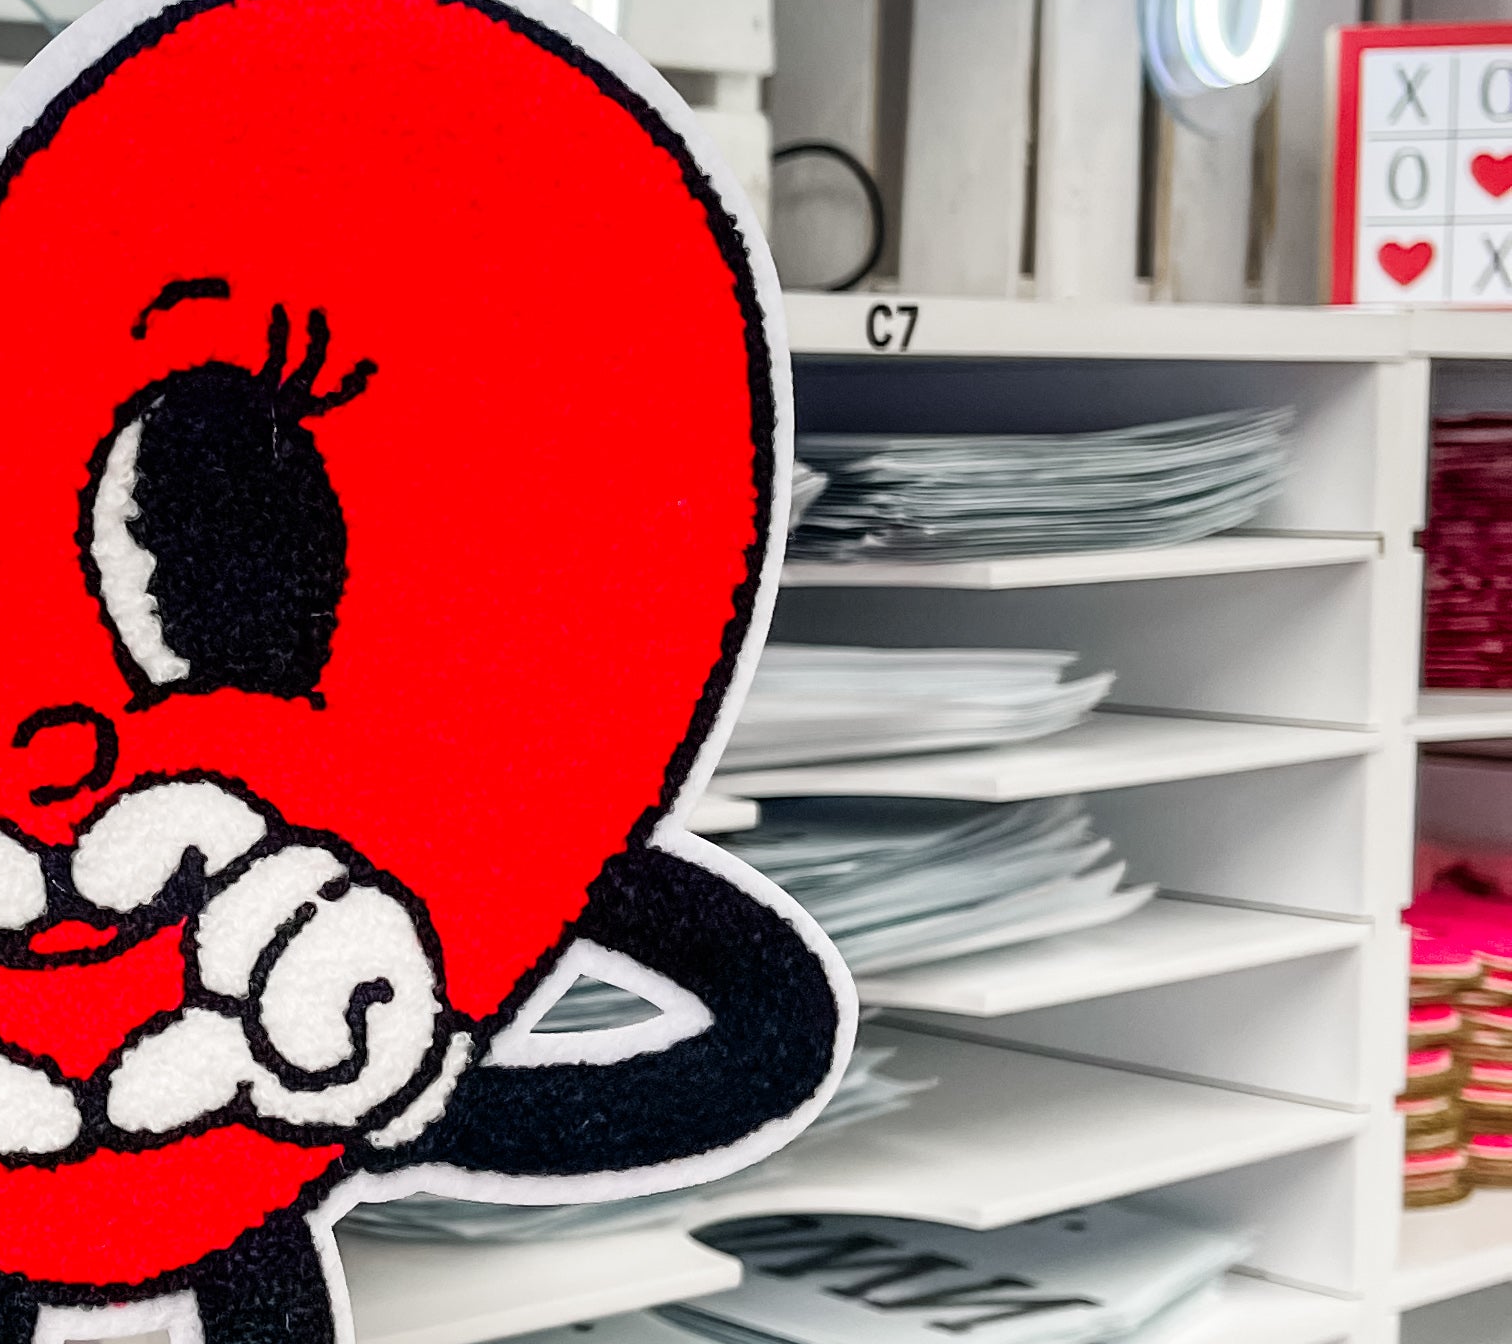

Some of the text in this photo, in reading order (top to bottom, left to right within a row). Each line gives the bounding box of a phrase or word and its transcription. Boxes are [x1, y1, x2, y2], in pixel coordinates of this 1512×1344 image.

[1389, 59, 1431, 126] X
[1388, 147, 1430, 210] O
[866, 304, 919, 352] C7
